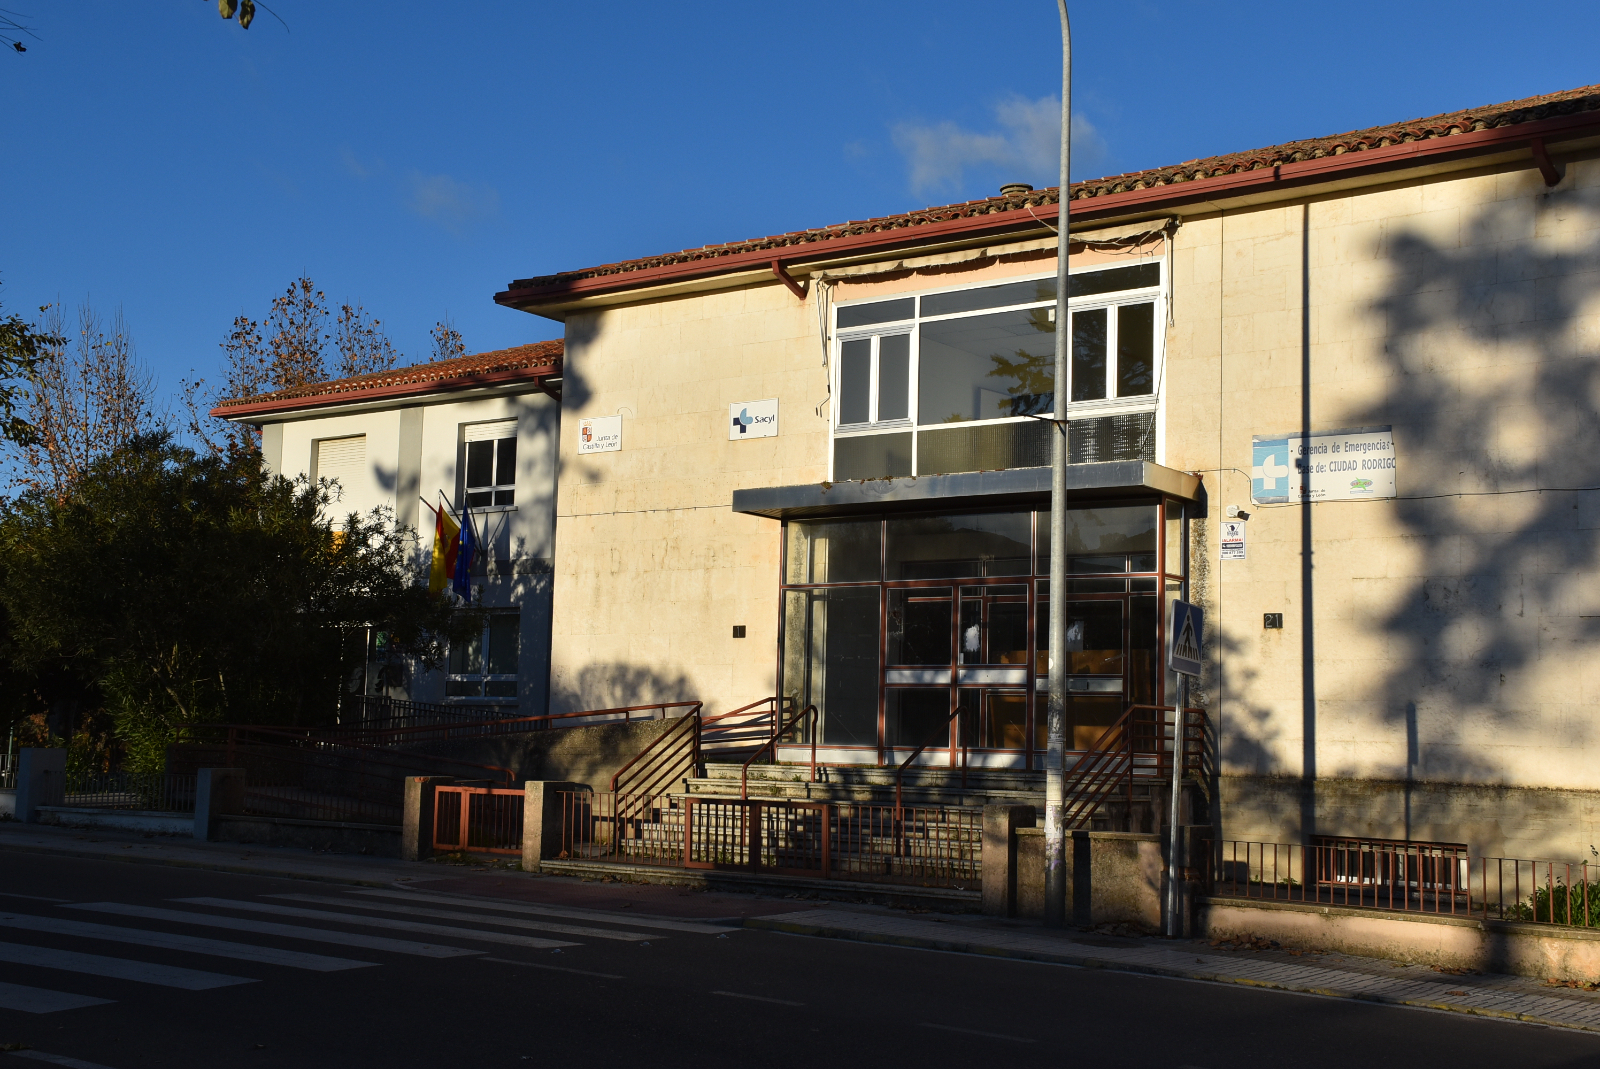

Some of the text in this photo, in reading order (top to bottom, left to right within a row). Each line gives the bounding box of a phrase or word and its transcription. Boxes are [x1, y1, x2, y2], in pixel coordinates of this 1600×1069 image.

[754, 414, 775, 424] Sacyl
[1297, 439, 1390, 456] Gerencia de Emergencias
[1297, 463, 1314, 475] Base
[1315, 461, 1327, 474] de:
[1329, 460, 1358, 472] CIUDAD
[1264, 614, 1279, 628] 21
